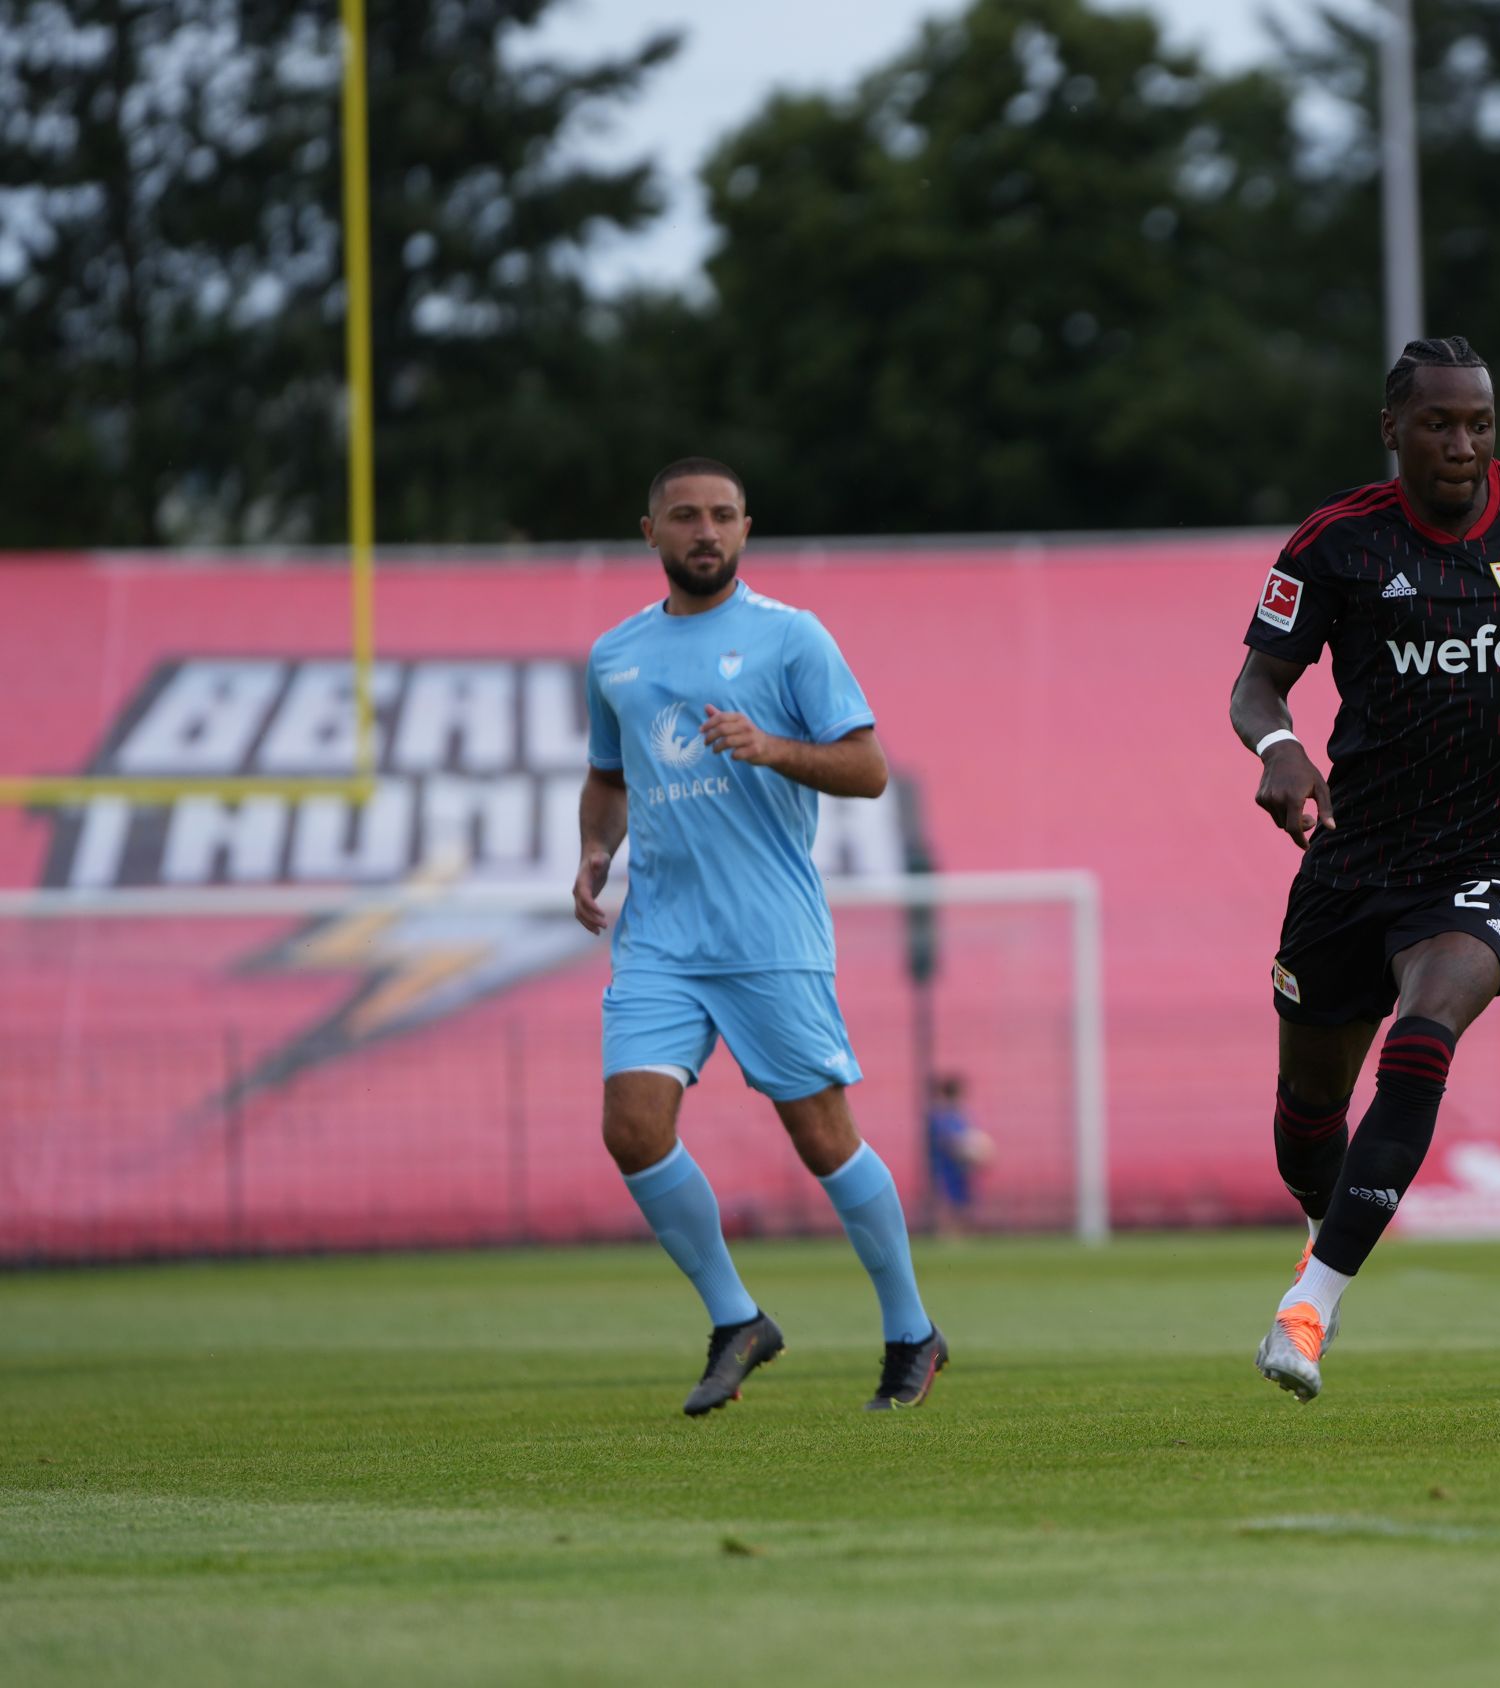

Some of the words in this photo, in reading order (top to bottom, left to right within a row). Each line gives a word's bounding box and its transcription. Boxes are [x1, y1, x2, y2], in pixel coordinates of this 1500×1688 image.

[1381, 586, 1418, 599] adidas
[1259, 607, 1290, 627] BUNDESLIGA
[668, 776, 731, 800] BLACK
